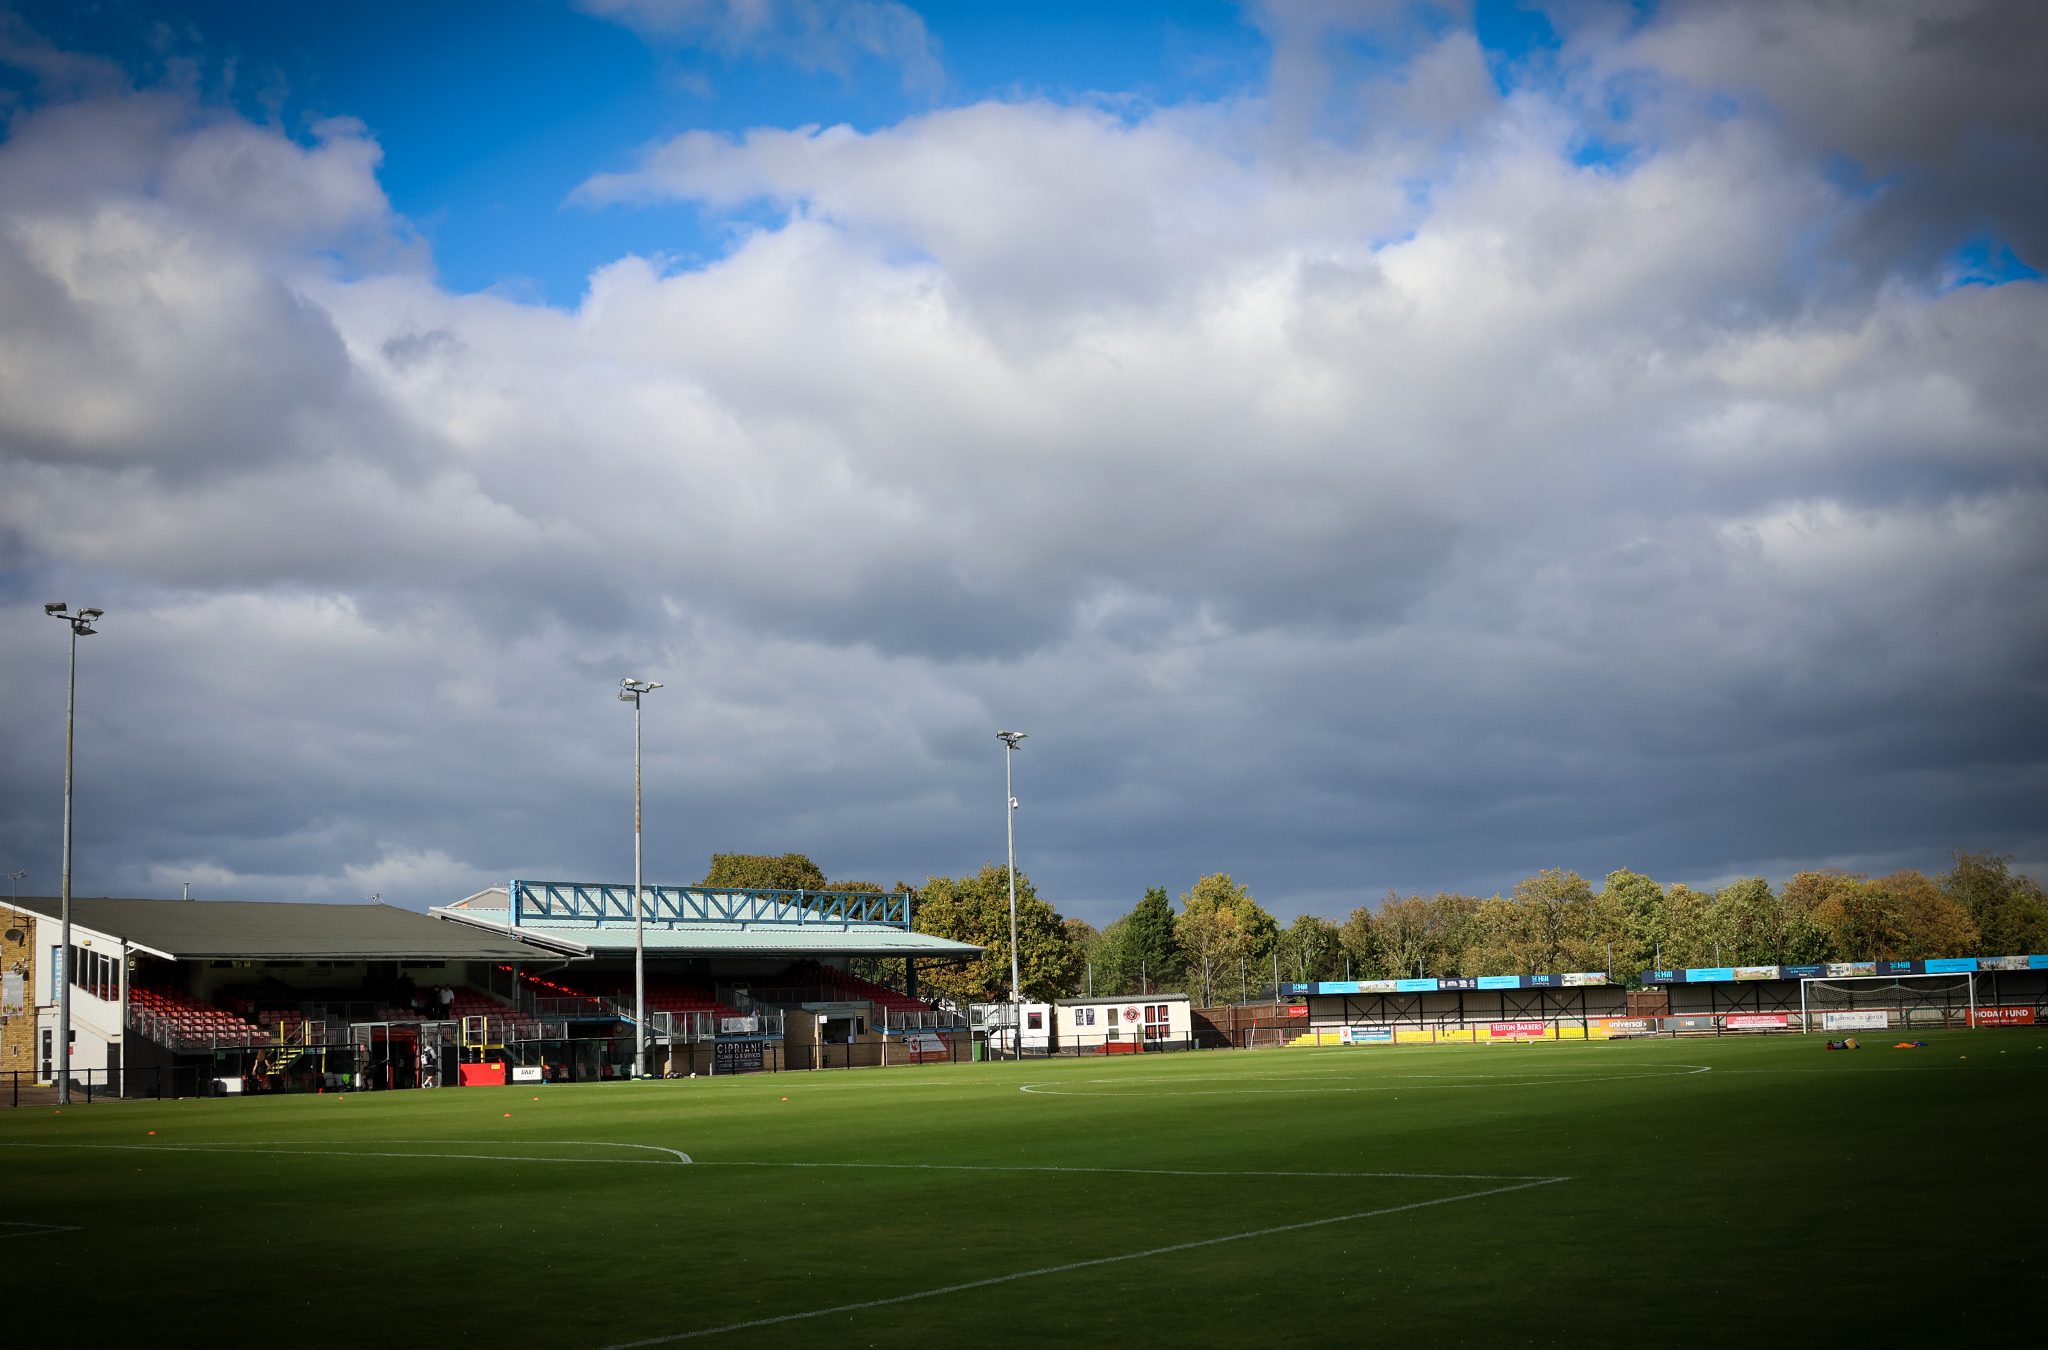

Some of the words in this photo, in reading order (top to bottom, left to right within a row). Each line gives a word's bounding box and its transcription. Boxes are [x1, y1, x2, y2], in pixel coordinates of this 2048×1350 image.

[1970, 1010, 2002, 1018] HODAY
[2005, 1009, 2029, 1017] FUND
[1492, 1023, 1515, 1031] HISTON
[1517, 1022, 1542, 1030] BARBERS
[717, 1042, 760, 1053] CIPRIANI
